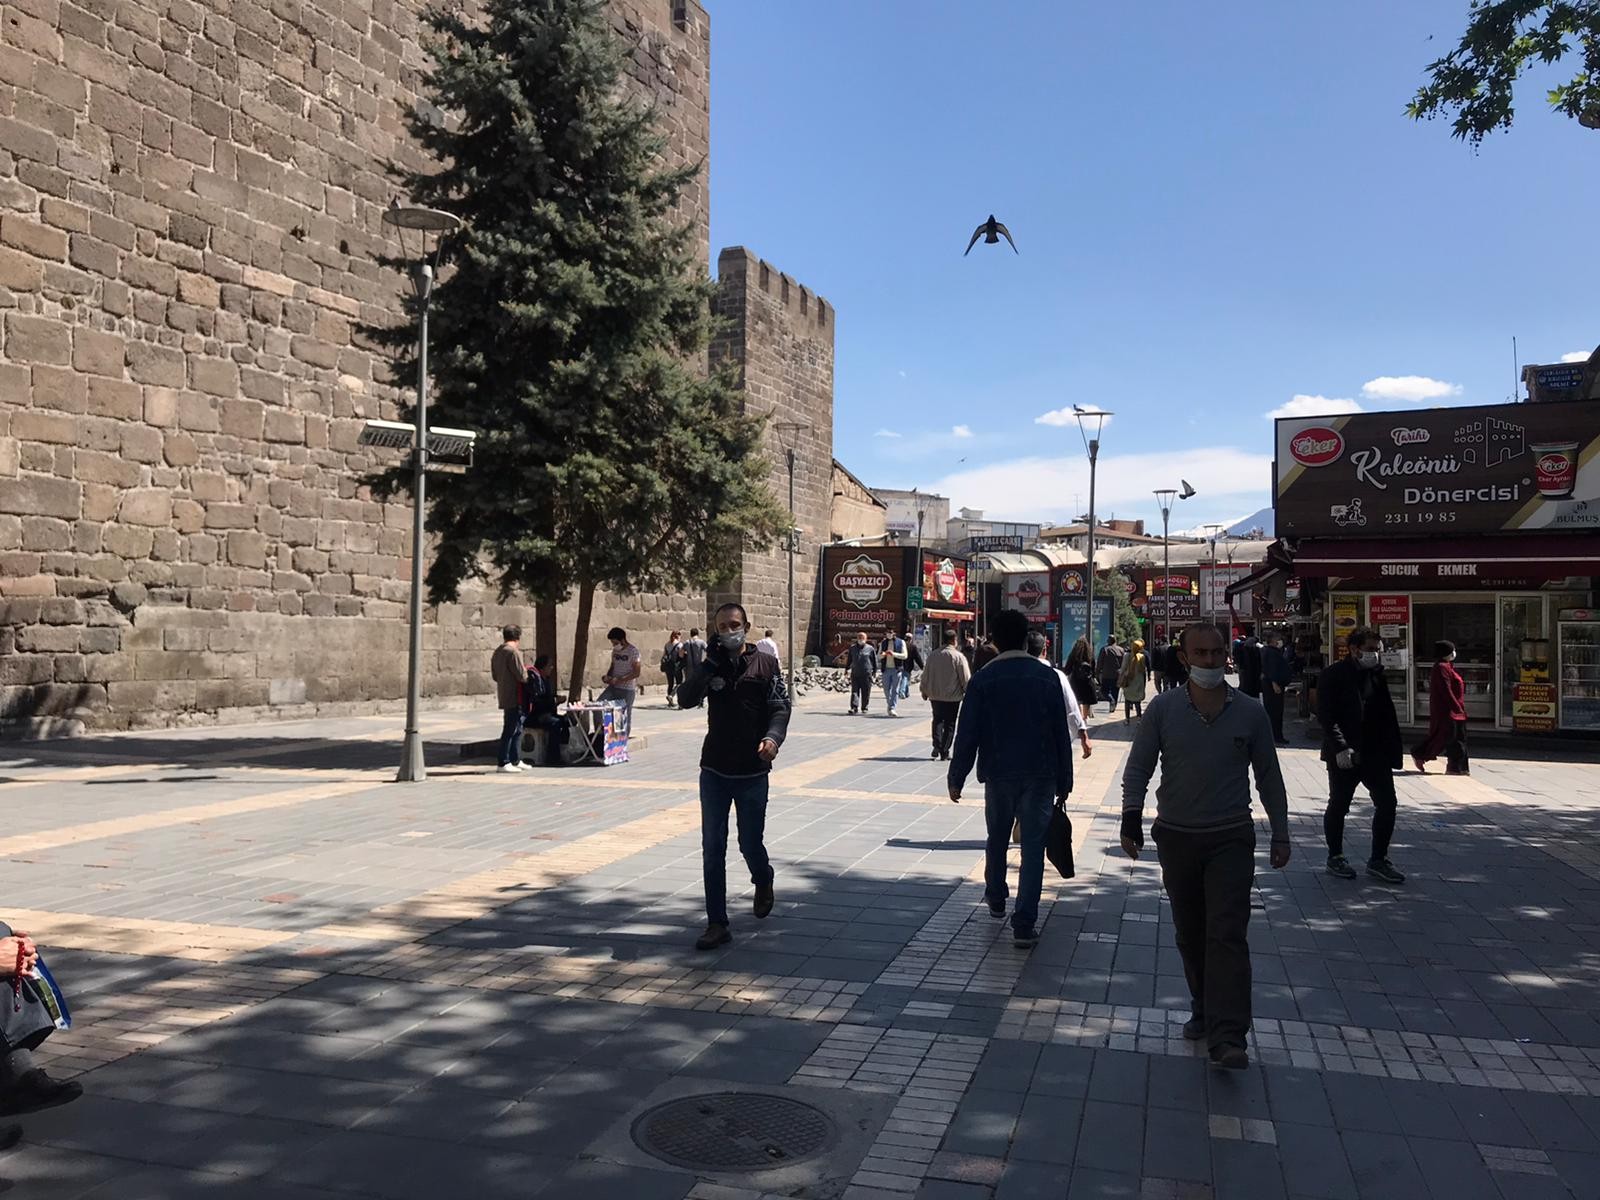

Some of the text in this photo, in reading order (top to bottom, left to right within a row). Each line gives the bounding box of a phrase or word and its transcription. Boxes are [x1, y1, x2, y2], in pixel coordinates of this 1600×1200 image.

[1391, 428, 1430, 446] Tarihi
[1350, 446, 1462, 490] Kaleönü
[1384, 512, 1456, 524] 231 19 85
[1380, 564, 1478, 577] SUCUK EKMEK
[839, 576, 885, 588] BAŞYAZICI
[830, 608, 895, 623] Palamutoğlu
